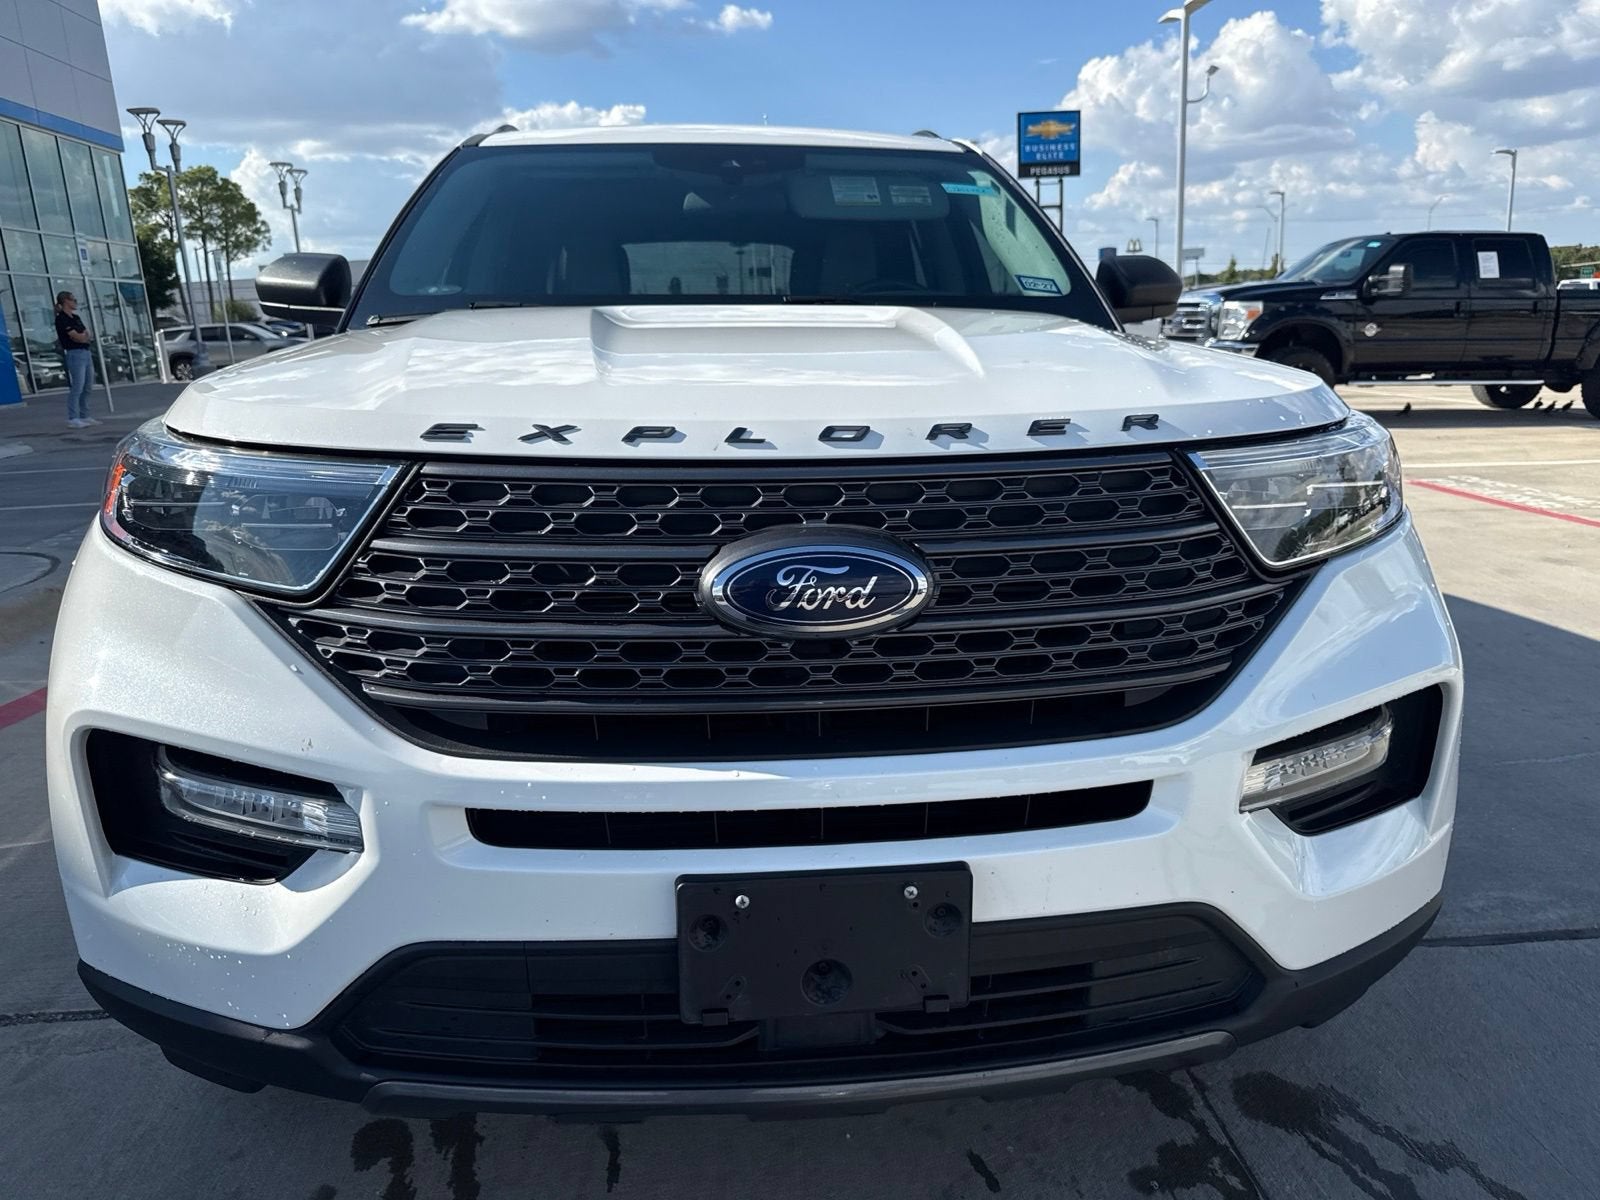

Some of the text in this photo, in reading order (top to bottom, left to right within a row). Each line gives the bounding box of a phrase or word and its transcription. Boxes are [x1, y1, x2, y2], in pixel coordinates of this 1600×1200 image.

[1024, 143, 1075, 152] BUSINESS
[1030, 166, 1070, 175] PEGASUS
[419, 413, 1160, 444] EXPLORER
[765, 564, 878, 611] Ford
